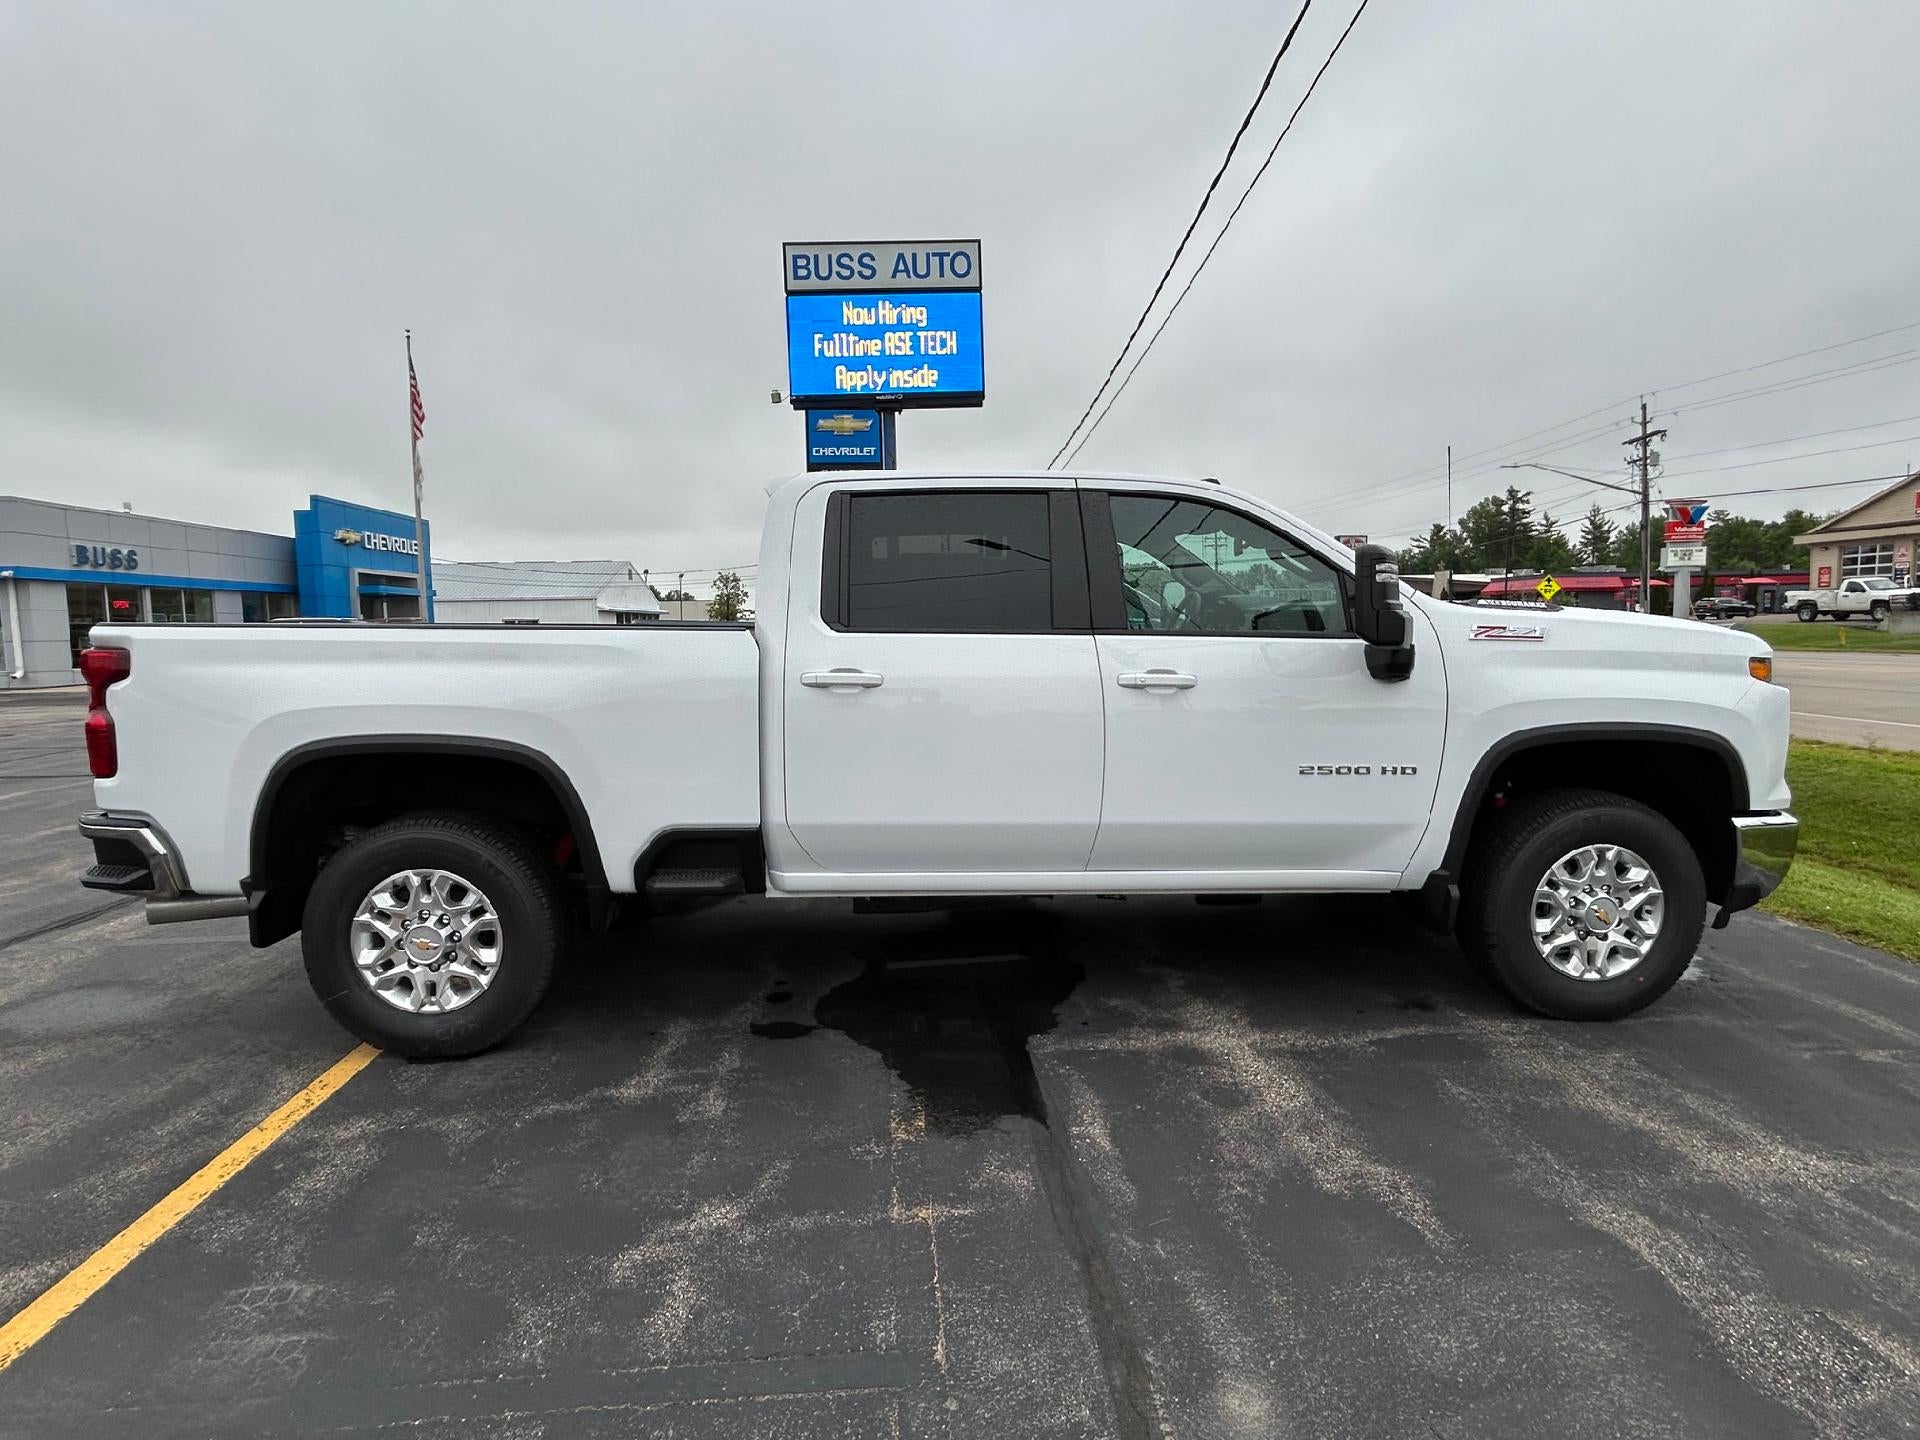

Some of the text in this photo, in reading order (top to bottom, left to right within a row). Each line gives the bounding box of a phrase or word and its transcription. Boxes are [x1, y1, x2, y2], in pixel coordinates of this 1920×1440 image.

[792, 251, 972, 281] BUSS AUTO
[842, 301, 928, 327] Now Hiring
[814, 331, 957, 358] Fulltime ASE TECH
[835, 364, 939, 391] Apply inside
[812, 447, 877, 456] CHEVROLET
[364, 532, 420, 555] CHEVROLE
[71, 544, 139, 571] BUSS
[1298, 765, 1418, 776] 2500 HD
